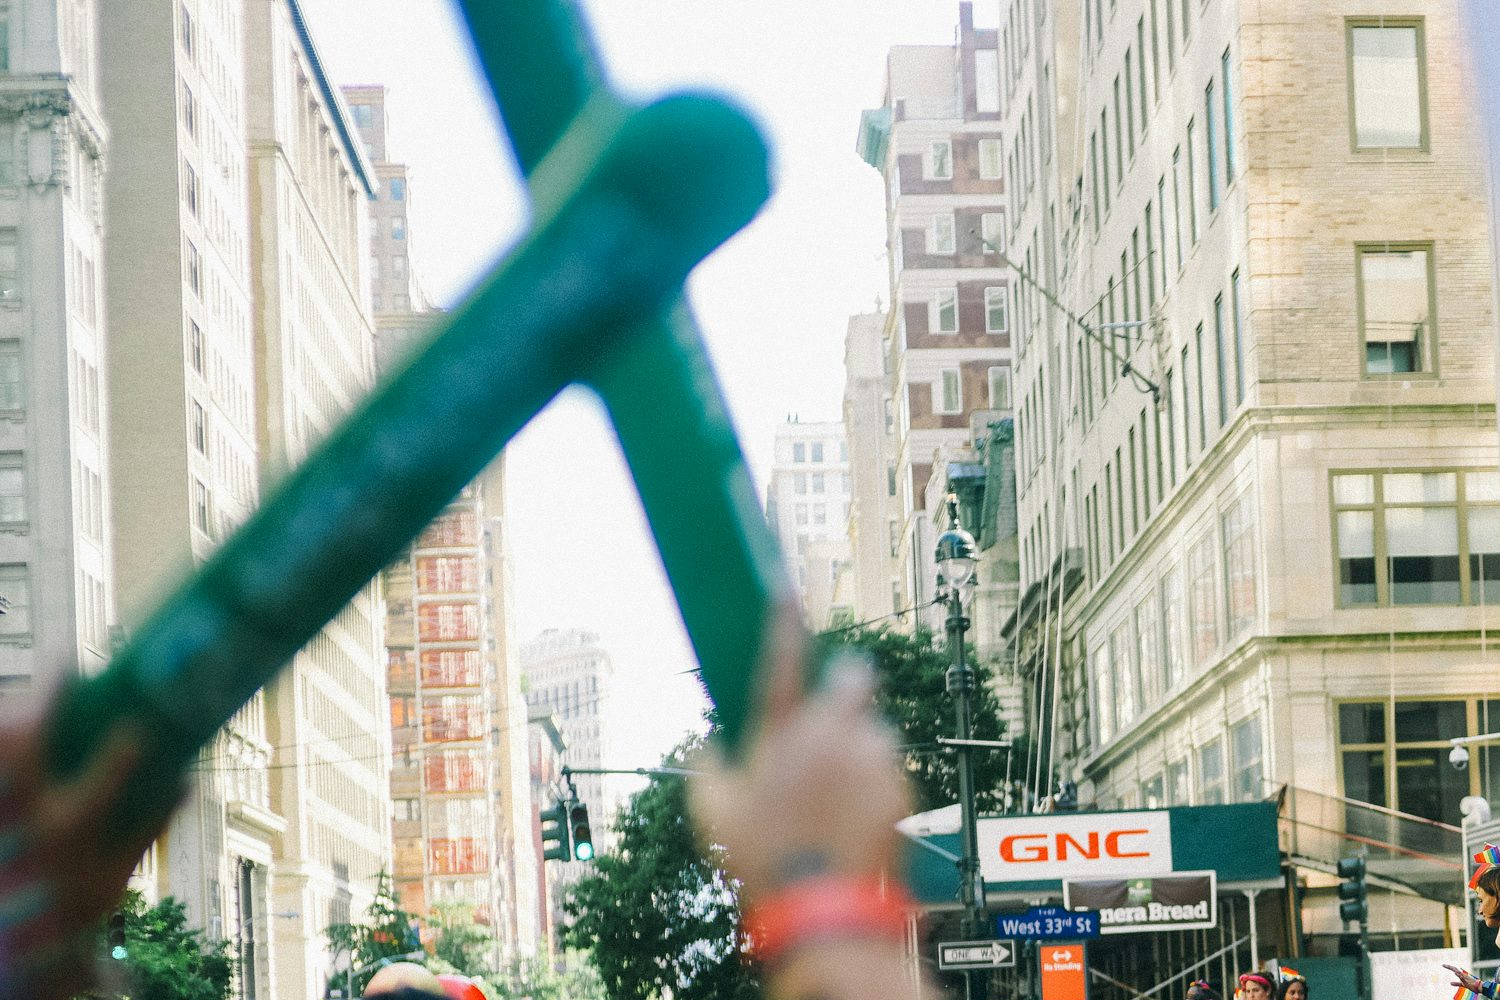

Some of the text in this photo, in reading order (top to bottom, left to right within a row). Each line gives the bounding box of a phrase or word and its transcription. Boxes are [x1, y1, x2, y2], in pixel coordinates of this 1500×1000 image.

[1000, 829, 1150, 863] GNC
[1148, 900, 1208, 922] Bread
[1002, 916, 1092, 935] West 33rd St
[951, 946, 1002, 960] ONE WAY
[1043, 962, 1081, 971] No Standing
